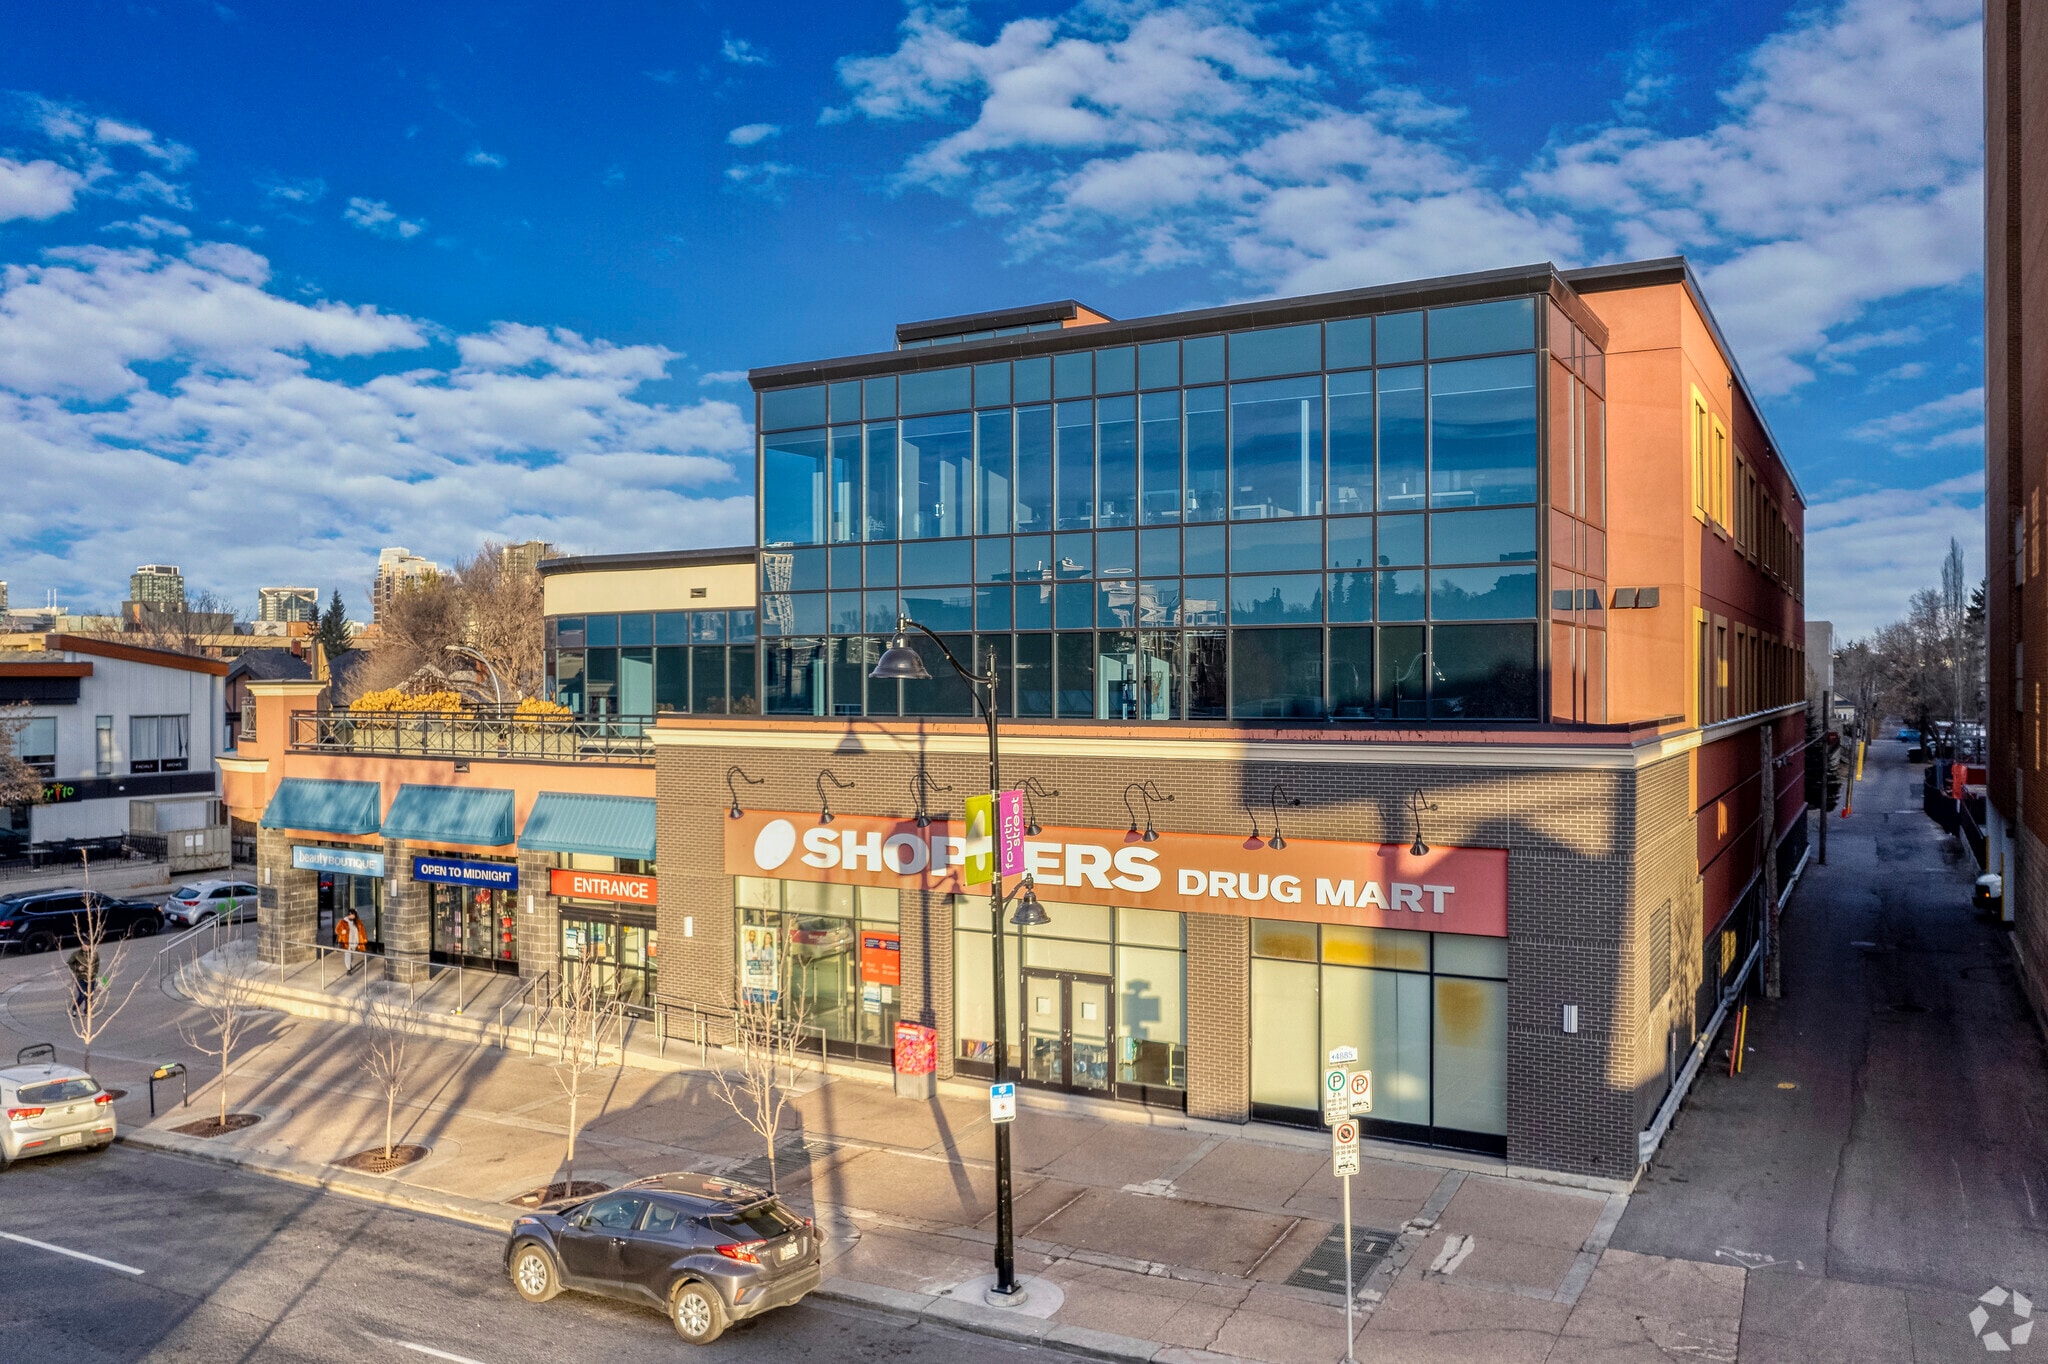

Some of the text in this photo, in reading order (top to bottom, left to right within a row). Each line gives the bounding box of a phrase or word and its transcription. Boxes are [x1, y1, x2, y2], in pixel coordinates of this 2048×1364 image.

[1011, 796, 1020, 847] street
[1004, 816, 1014, 870] fourth
[421, 864, 512, 883] OPEN TO MIDNIGHT
[800, 826, 1455, 913] SHOPERS DRUG MART
[574, 877, 649, 899] ENTRANCE
[1332, 1075, 1341, 1088] P
